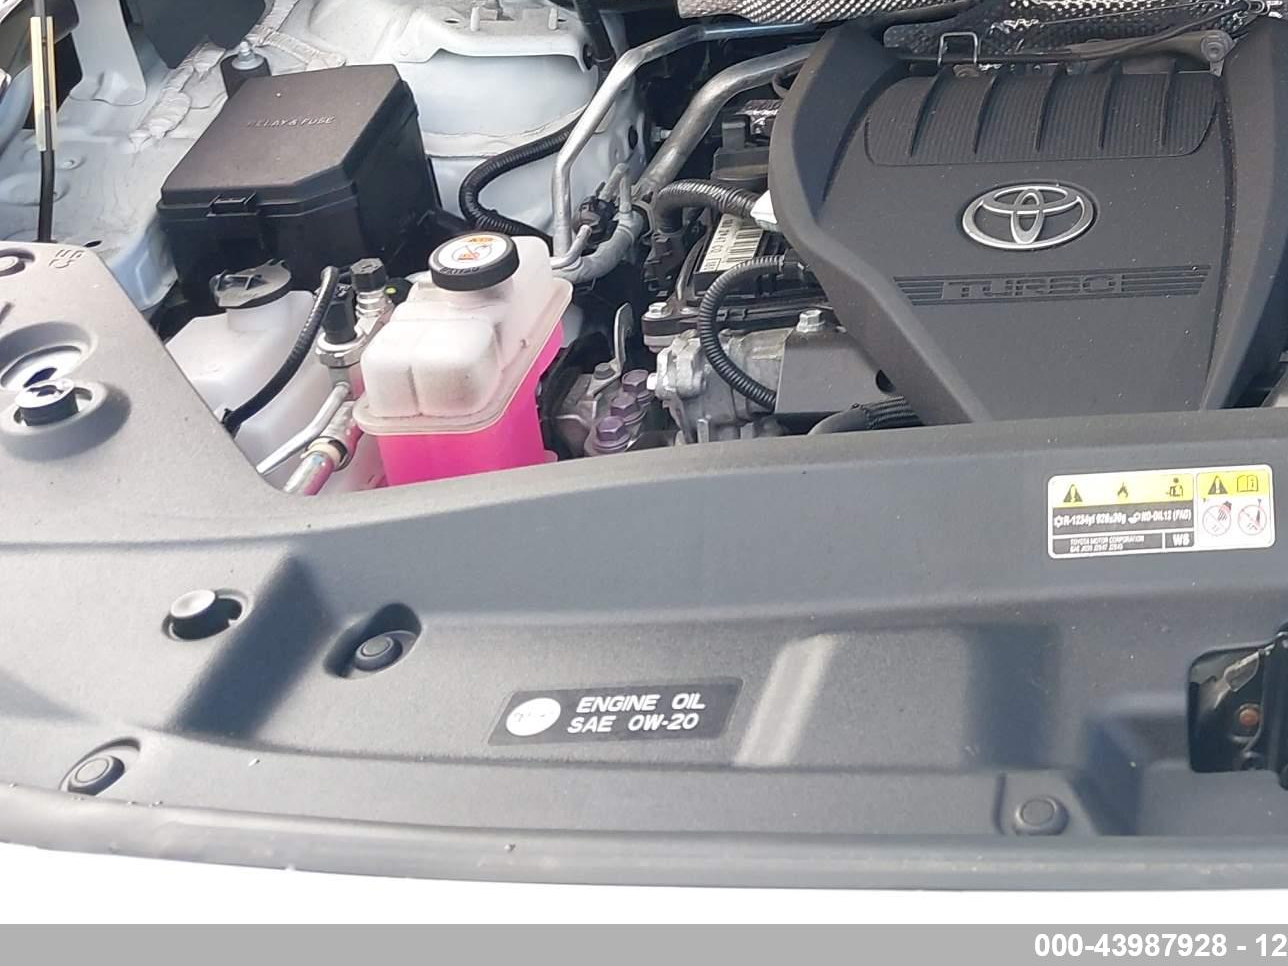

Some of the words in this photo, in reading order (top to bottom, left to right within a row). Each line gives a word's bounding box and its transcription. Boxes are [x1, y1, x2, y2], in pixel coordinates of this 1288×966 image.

[948, 274, 1116, 298] TURBO
[576, 694, 660, 713] ENGINE
[671, 692, 706, 710] OIL
[567, 715, 616, 733] SAE
[627, 713, 699, 731] 0W-20
